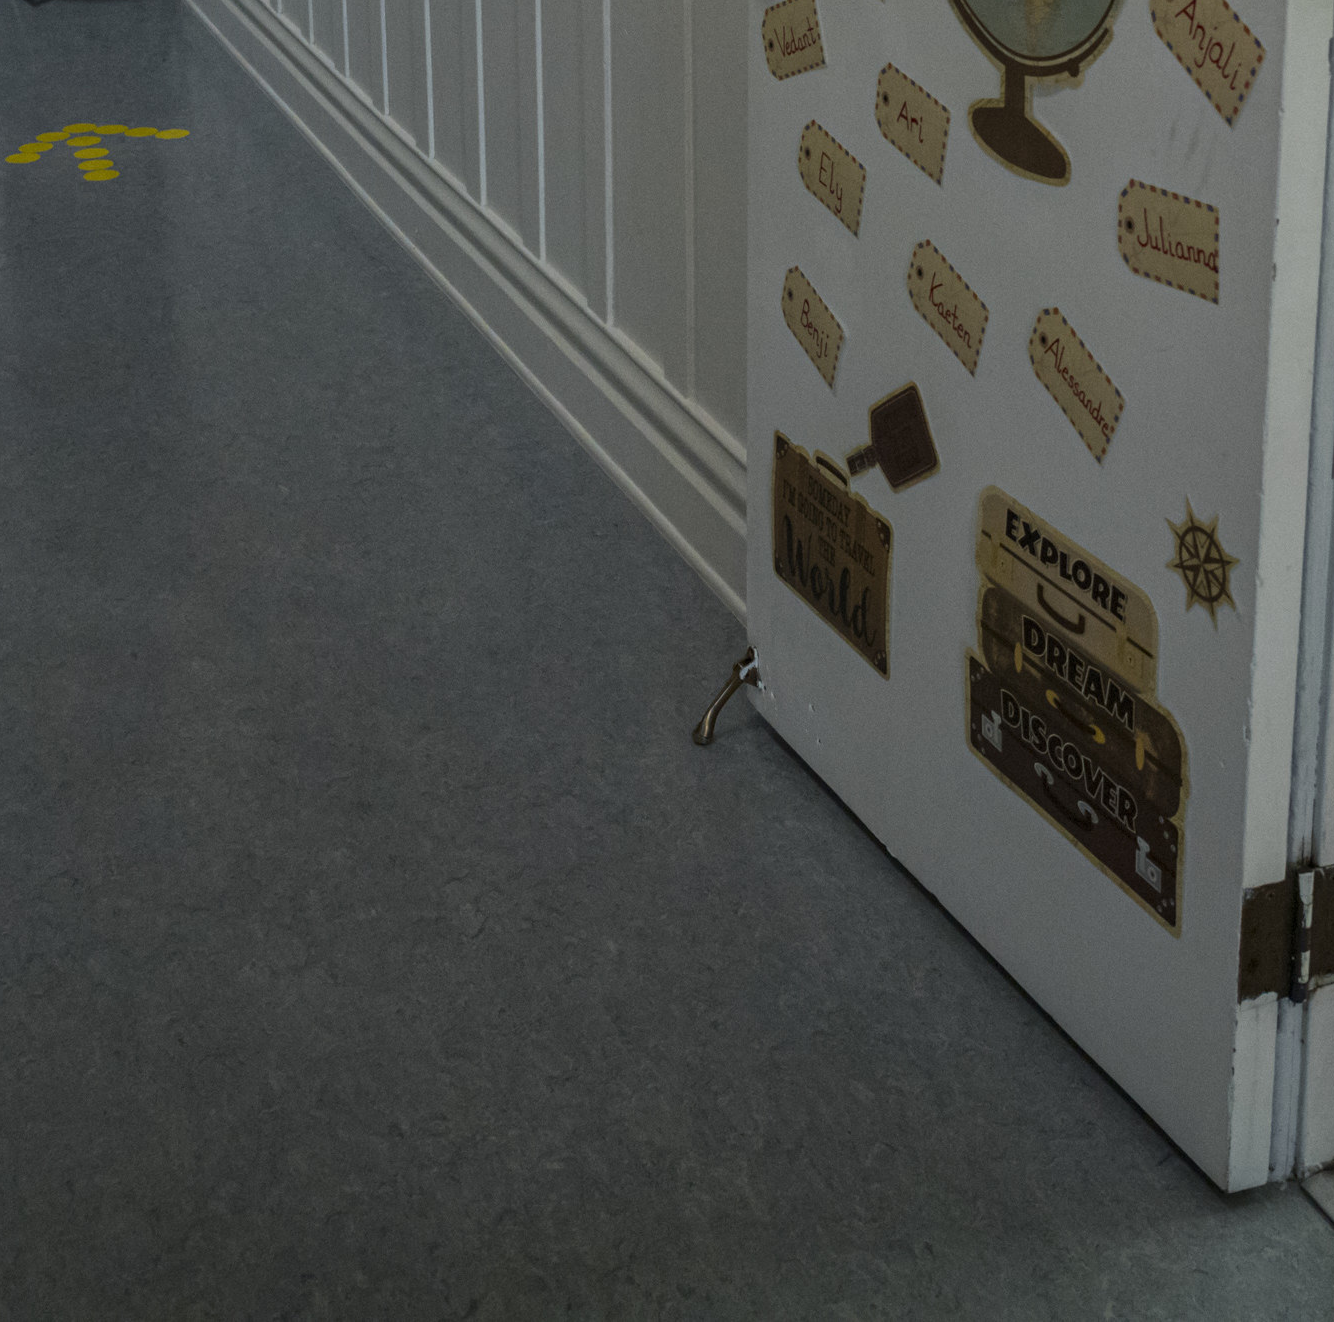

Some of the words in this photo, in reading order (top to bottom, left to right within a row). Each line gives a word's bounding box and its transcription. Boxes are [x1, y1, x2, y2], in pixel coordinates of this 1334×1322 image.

[774, 16, 817, 58] Vedant
[897, 100, 924, 145] Ari
[819, 151, 843, 214] Ely
[1137, 207, 1219, 274] Julianna
[800, 298, 830, 360] Benji
[808, 475, 851, 527] SOMEDAY
[782, 513, 877, 647] World
[839, 529, 875, 577] TRAVEL
[1005, 508, 1128, 622] EXPLORE
[1022, 615, 1135, 732] DREAM
[1000, 688, 1139, 833] DISCOVER
